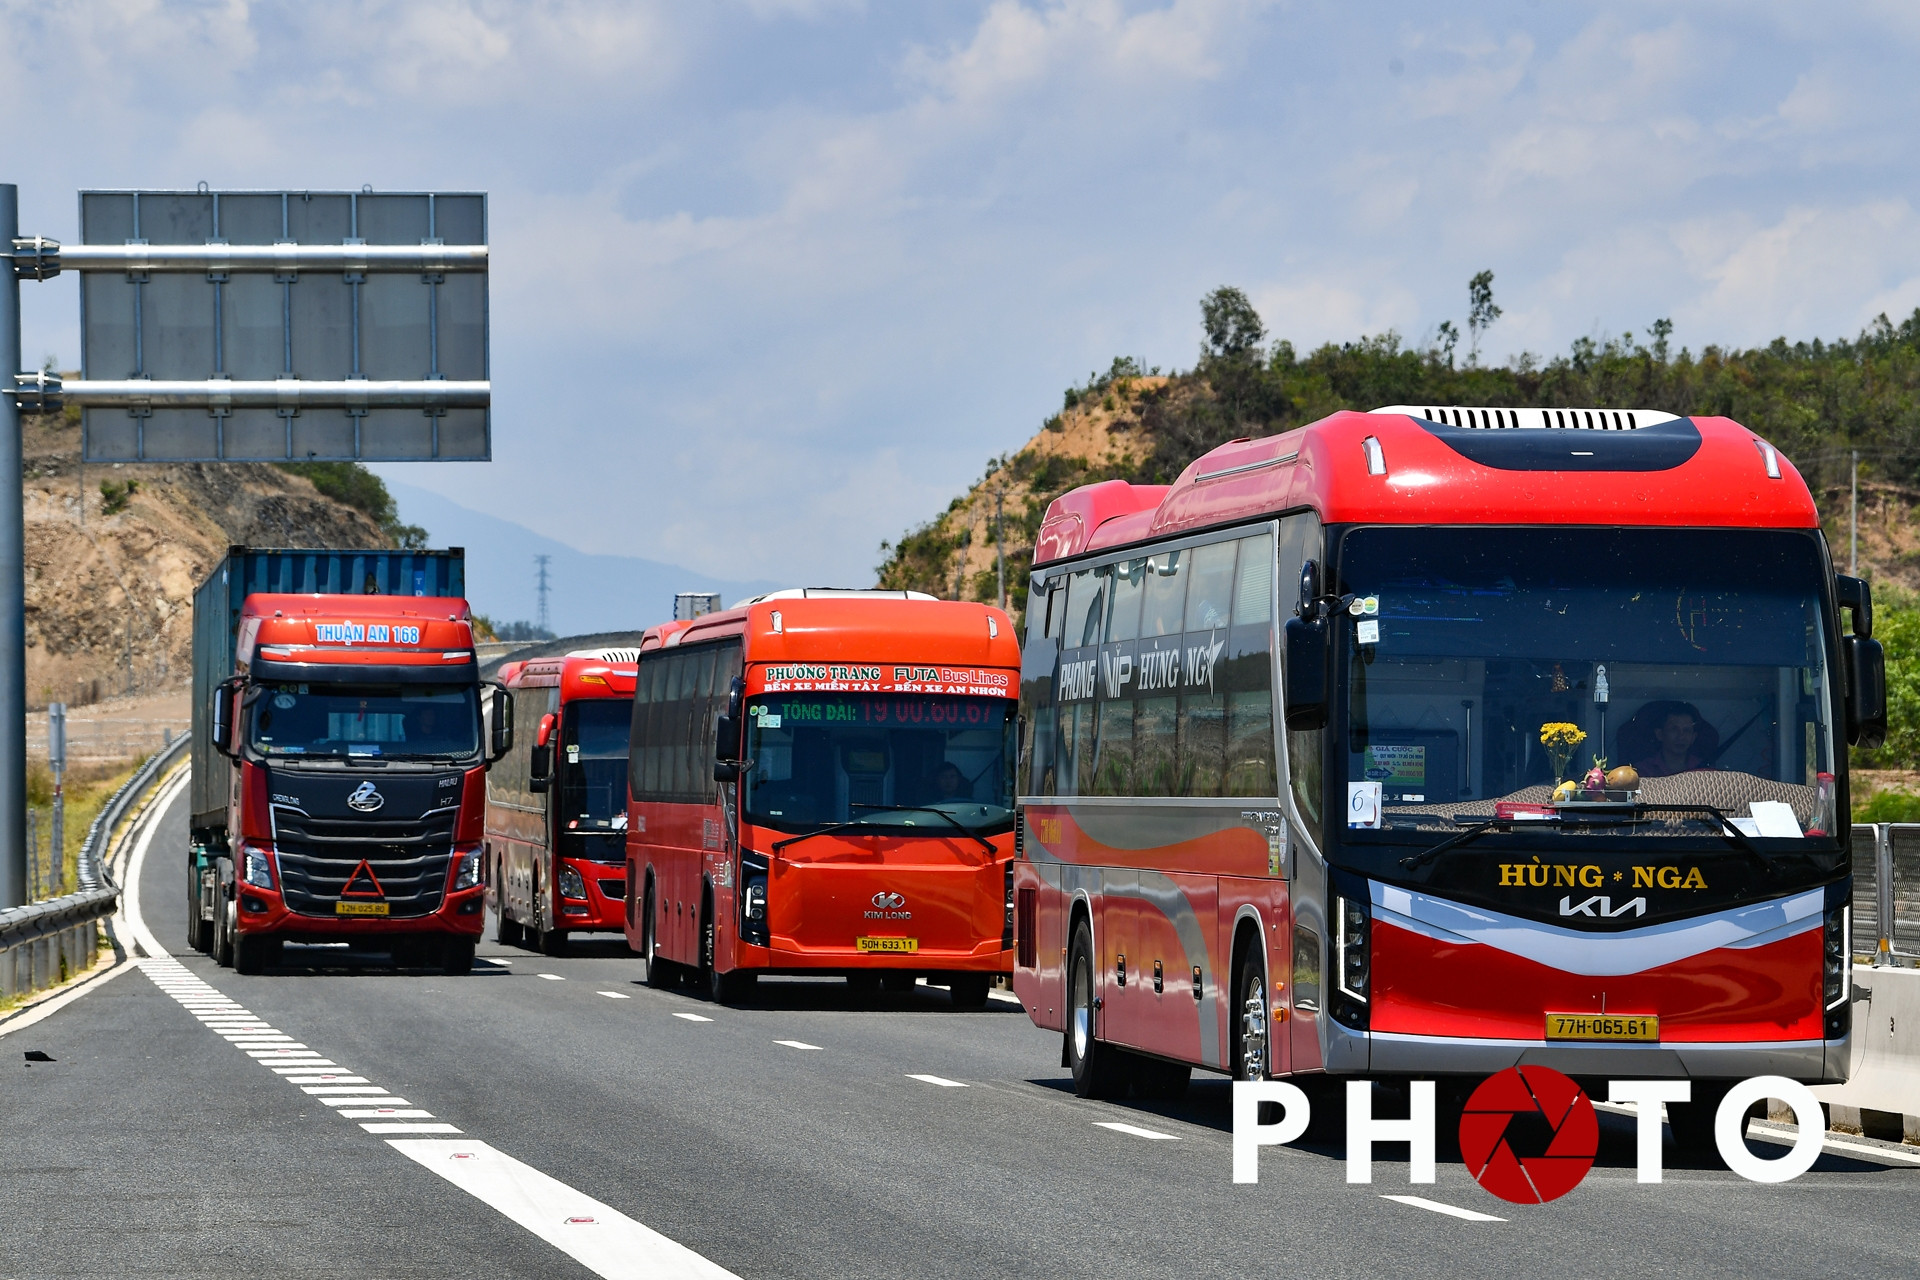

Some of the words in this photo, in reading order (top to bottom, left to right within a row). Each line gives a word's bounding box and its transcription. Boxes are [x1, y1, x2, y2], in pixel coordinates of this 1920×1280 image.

[315, 620, 364, 645] THUẬN
[367, 625, 389, 642] AN
[392, 626, 419, 644] 168
[766, 664, 826, 681] PHƯƠNG
[829, 665, 881, 681] TRANG
[894, 666, 940, 681] FUTA
[942, 668, 968, 683] Bus
[970, 669, 1008, 686] Lines
[1102, 645, 1132, 698] VIP
[1138, 639, 1180, 690] HÙNG
[764, 680, 791, 692] BẾN
[793, 682, 813, 690] XE
[815, 679, 850, 691] MIỀN
[852, 682, 881, 691] TÂY
[894, 680, 922, 692] BẾN
[925, 684, 943, 693] XE
[946, 685, 966, 694] AN
[969, 686, 1006, 697] NHƠN
[1352, 789, 1364, 812] 6
[1498, 855, 1604, 889] HÙNG
[1632, 866, 1708, 889] NGA
[864, 911, 883, 919] KIM
[885, 911, 912, 919] LONG
[1559, 895, 1646, 918] KIA
[861, 939, 913, 950] 50H-633.11
[1556, 1018, 1647, 1036] 77H-065.61
